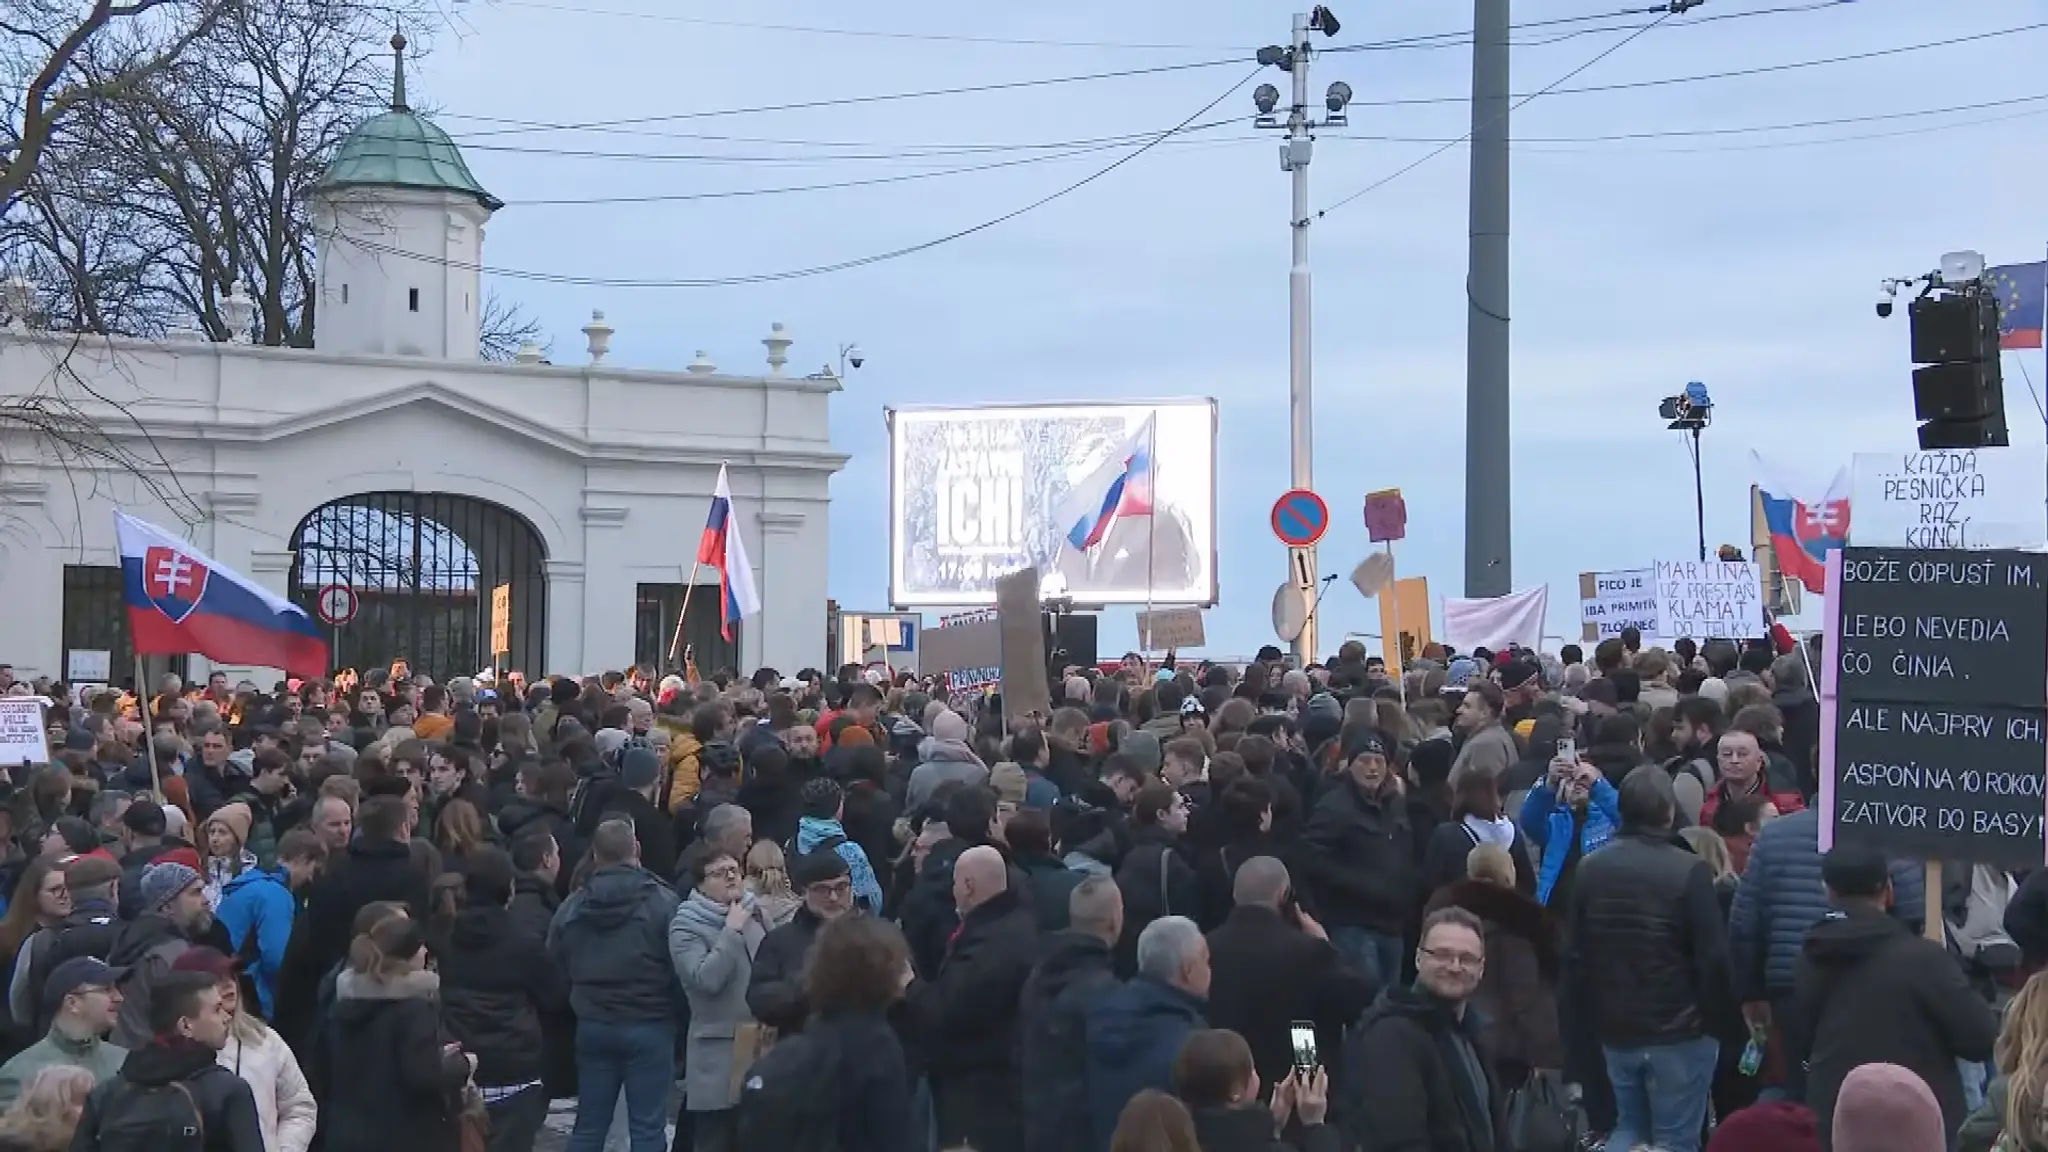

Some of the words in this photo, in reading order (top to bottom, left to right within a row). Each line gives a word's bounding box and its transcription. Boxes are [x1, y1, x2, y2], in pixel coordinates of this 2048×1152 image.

[1885, 472, 1985, 500] PESNIČKA
[1920, 502, 1960, 523] RAZ
[1657, 561, 1753, 581] MARTINA
[1844, 555, 1900, 582] BOŽE
[1909, 558, 1995, 585] ODPUSŤ
[1599, 580, 1626, 590] FICO
[1585, 604, 1606, 616] IBA
[1674, 620, 1693, 637] DO
[1703, 621, 1751, 637] TELKY
[1843, 614, 1906, 637] LEBO
[1916, 616, 2010, 642] NEVEDIA
[1842, 648, 1871, 675] ČO
[1846, 708, 1889, 731] ALE
[1901, 710, 1994, 737] NAJPRV
[1843, 761, 1920, 788] ASPOŇ
[1925, 768, 1955, 791] NA
[1959, 770, 1980, 793] 10
[1841, 800, 1926, 829] ZATVOR
[1938, 808, 1964, 831] DO
[1973, 811, 2044, 839] BASY!
